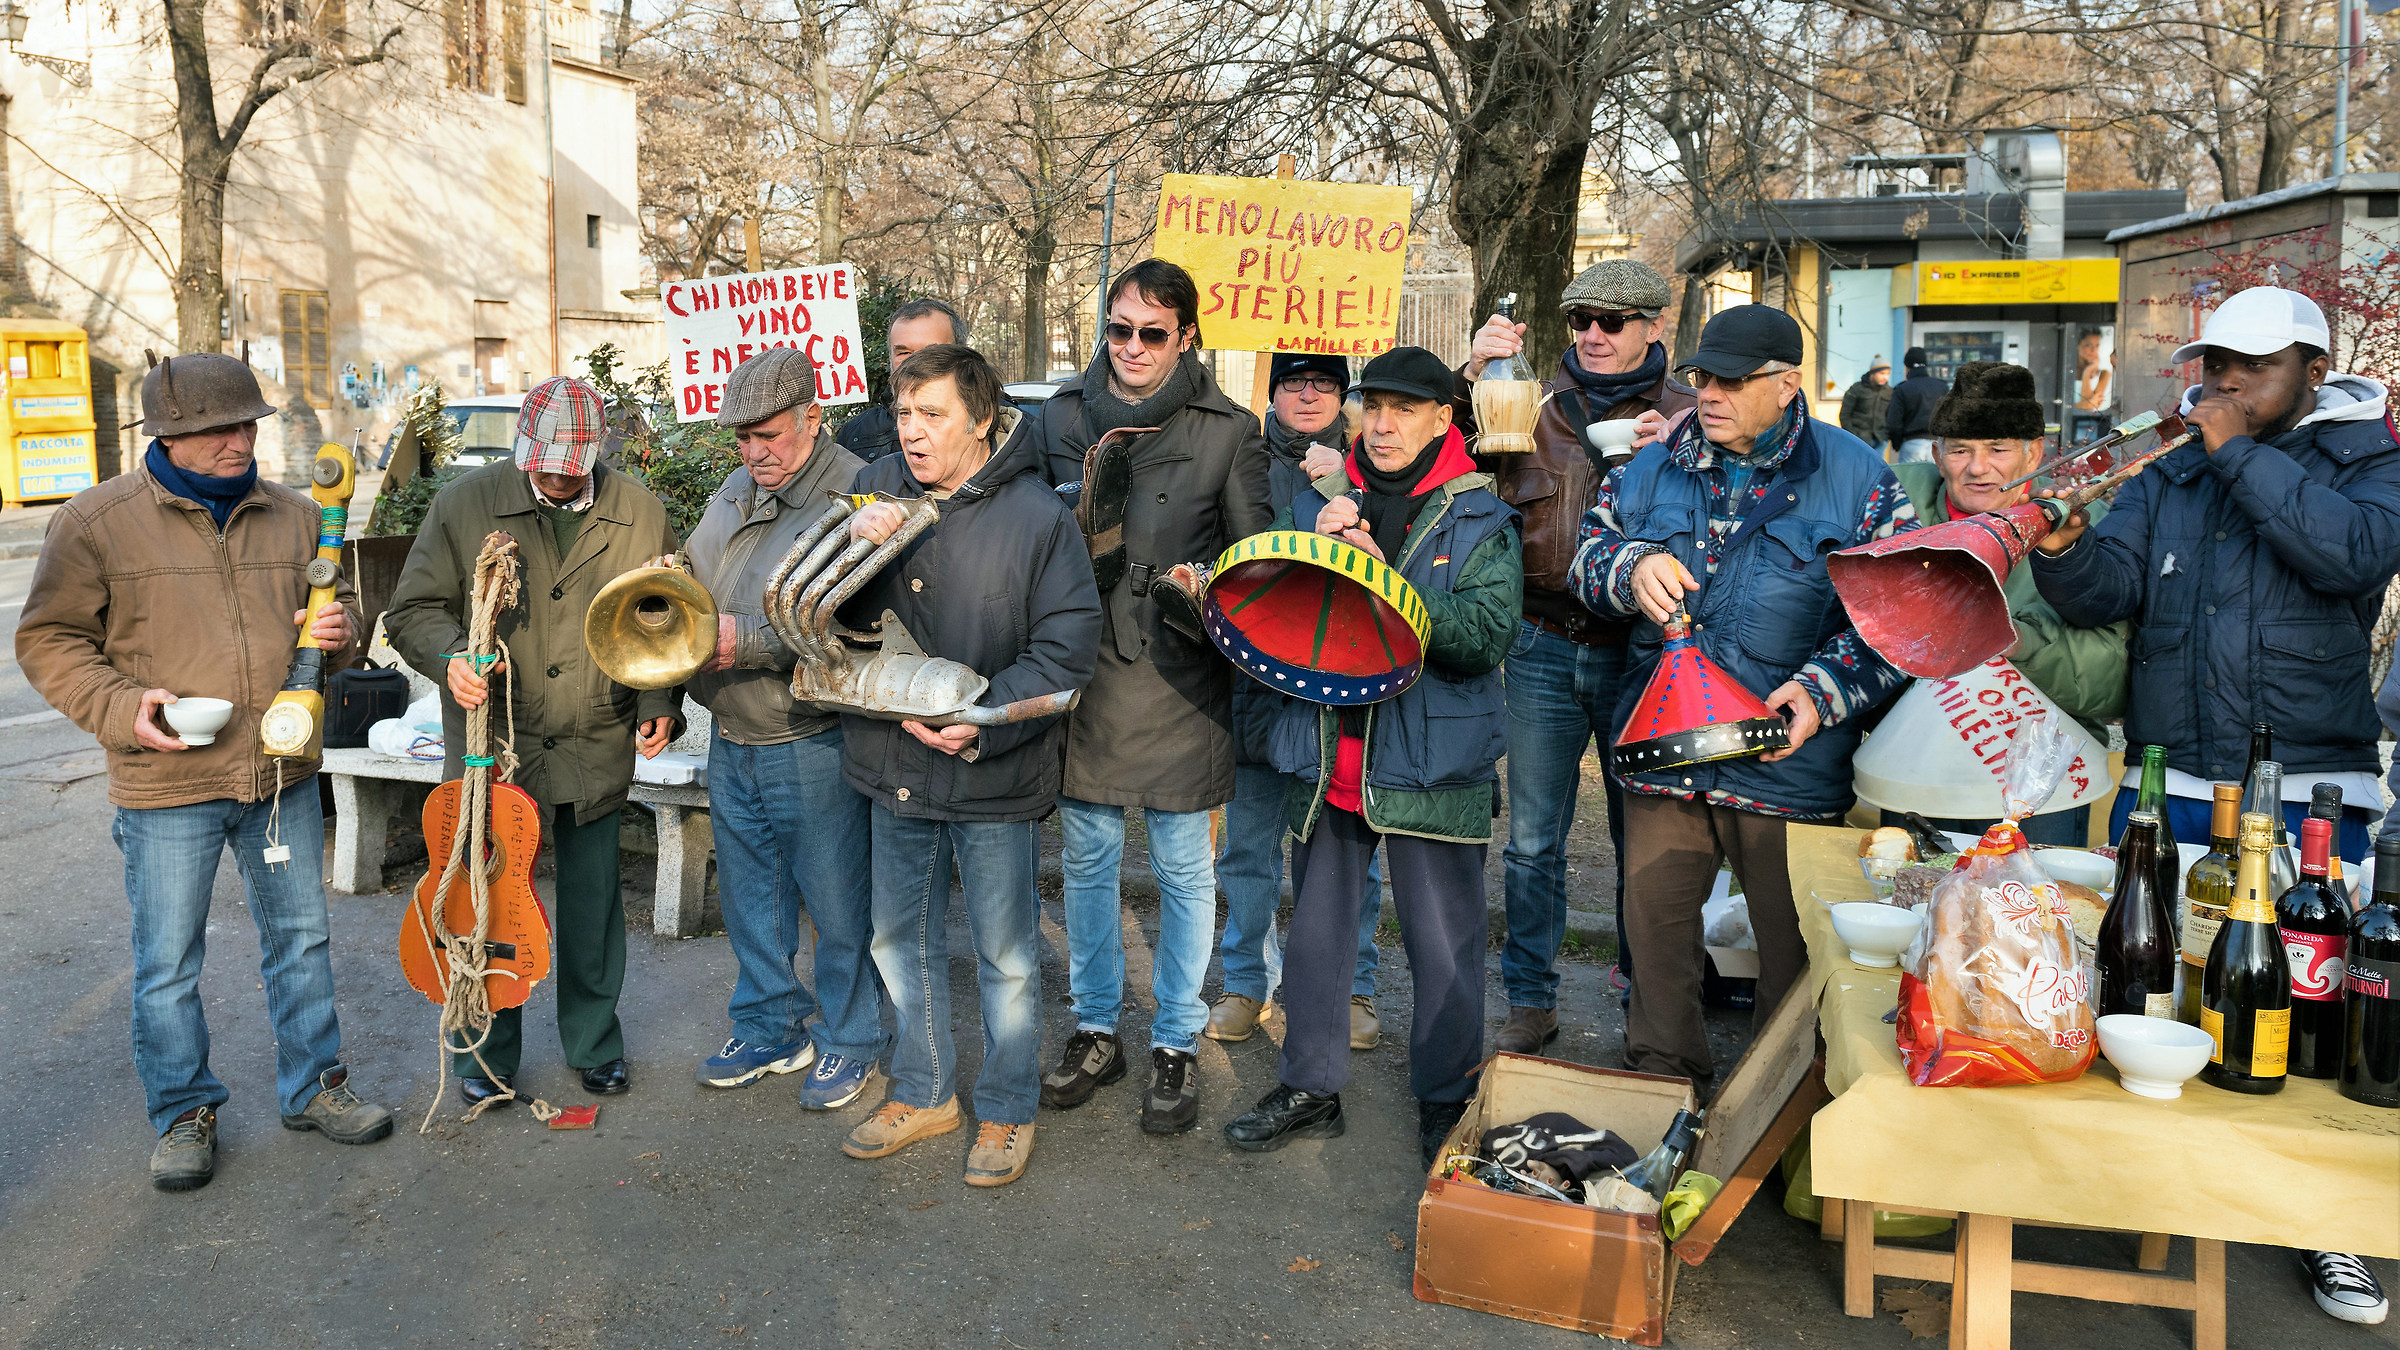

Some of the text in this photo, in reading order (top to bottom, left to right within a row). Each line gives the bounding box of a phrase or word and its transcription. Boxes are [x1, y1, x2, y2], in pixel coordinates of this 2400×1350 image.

[1164, 193, 1405, 253] MENO LAVORO
[666, 269, 849, 318] CHI NON BEVE
[738, 303, 812, 337] VINO
[21, 437, 85, 451] RACCOLTA
[22, 455, 87, 468] INDUMENTI
[23, 476, 56, 494] USATI
[2280, 929, 2324, 943] BONARDA
